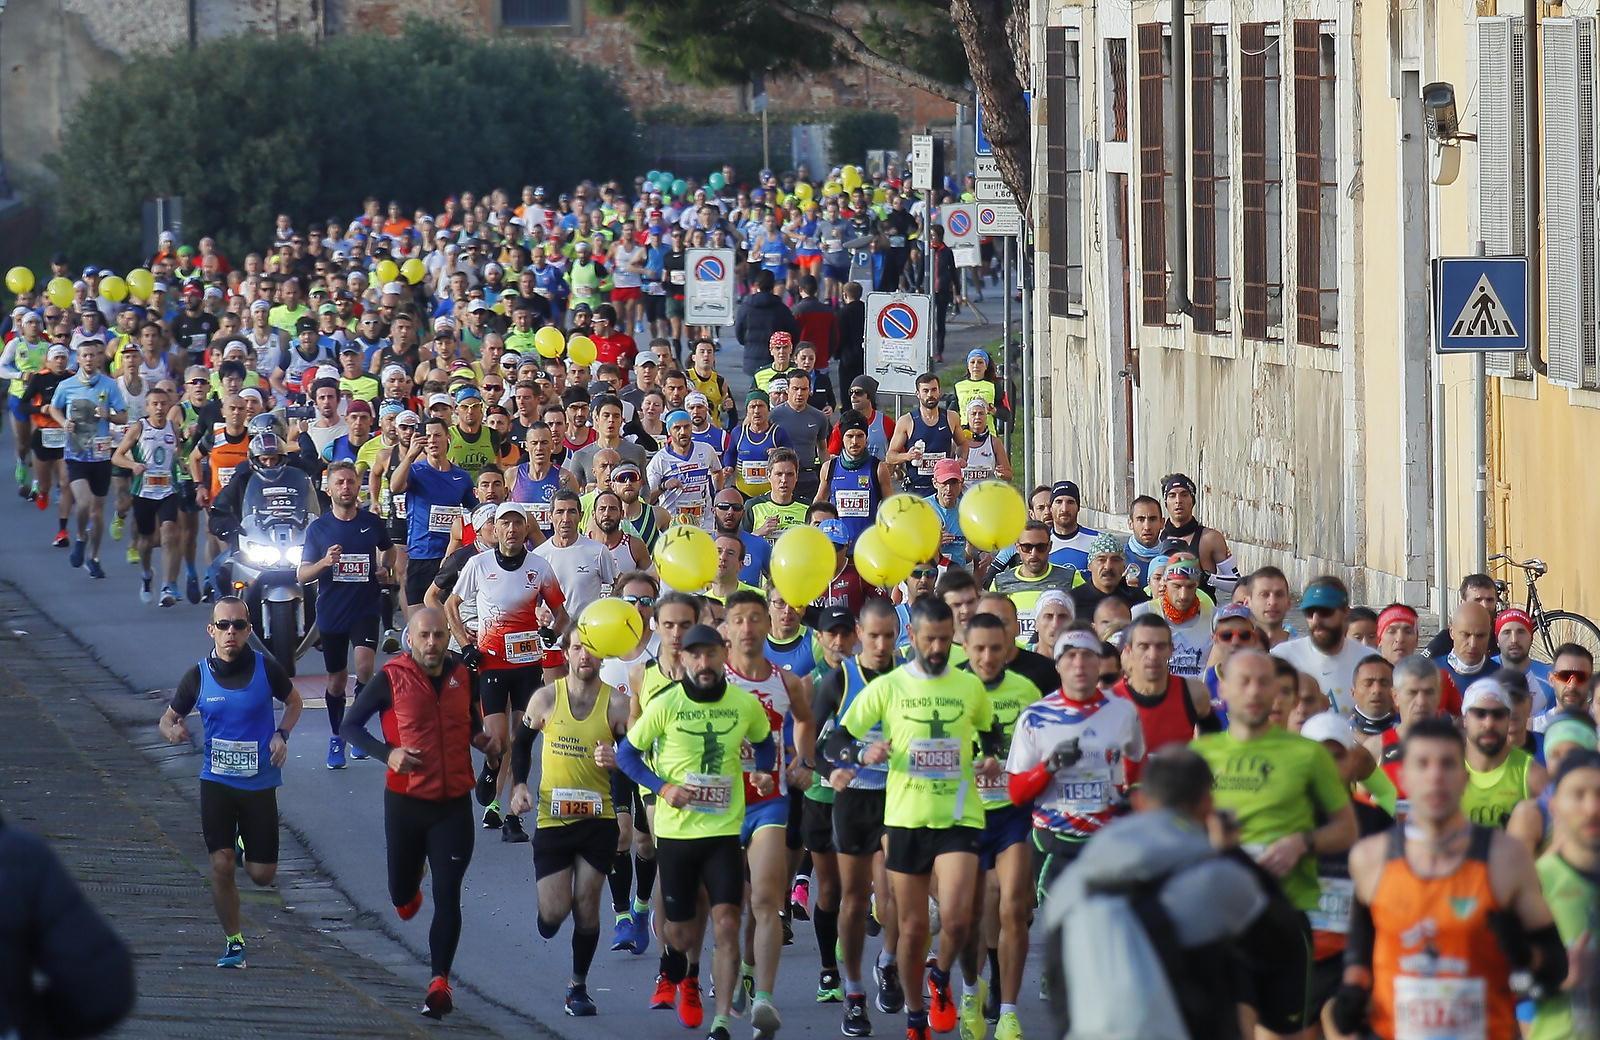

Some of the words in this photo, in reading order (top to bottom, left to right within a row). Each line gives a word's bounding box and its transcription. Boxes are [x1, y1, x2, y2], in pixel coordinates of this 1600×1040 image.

[342, 563, 360, 573] 494
[520, 641, 532, 652] 66
[901, 698, 932, 709] FRIENDS
[676, 709, 706, 720] FRIENDS
[709, 708, 739, 720] RUNNING
[558, 735, 580, 744] SOUTH
[550, 741, 588, 753] DERBYSHIRE
[219, 751, 249, 765] 3595
[917, 751, 952, 766] 3058
[1065, 783, 1102, 799] 1584
[565, 801, 588, 815] 125
